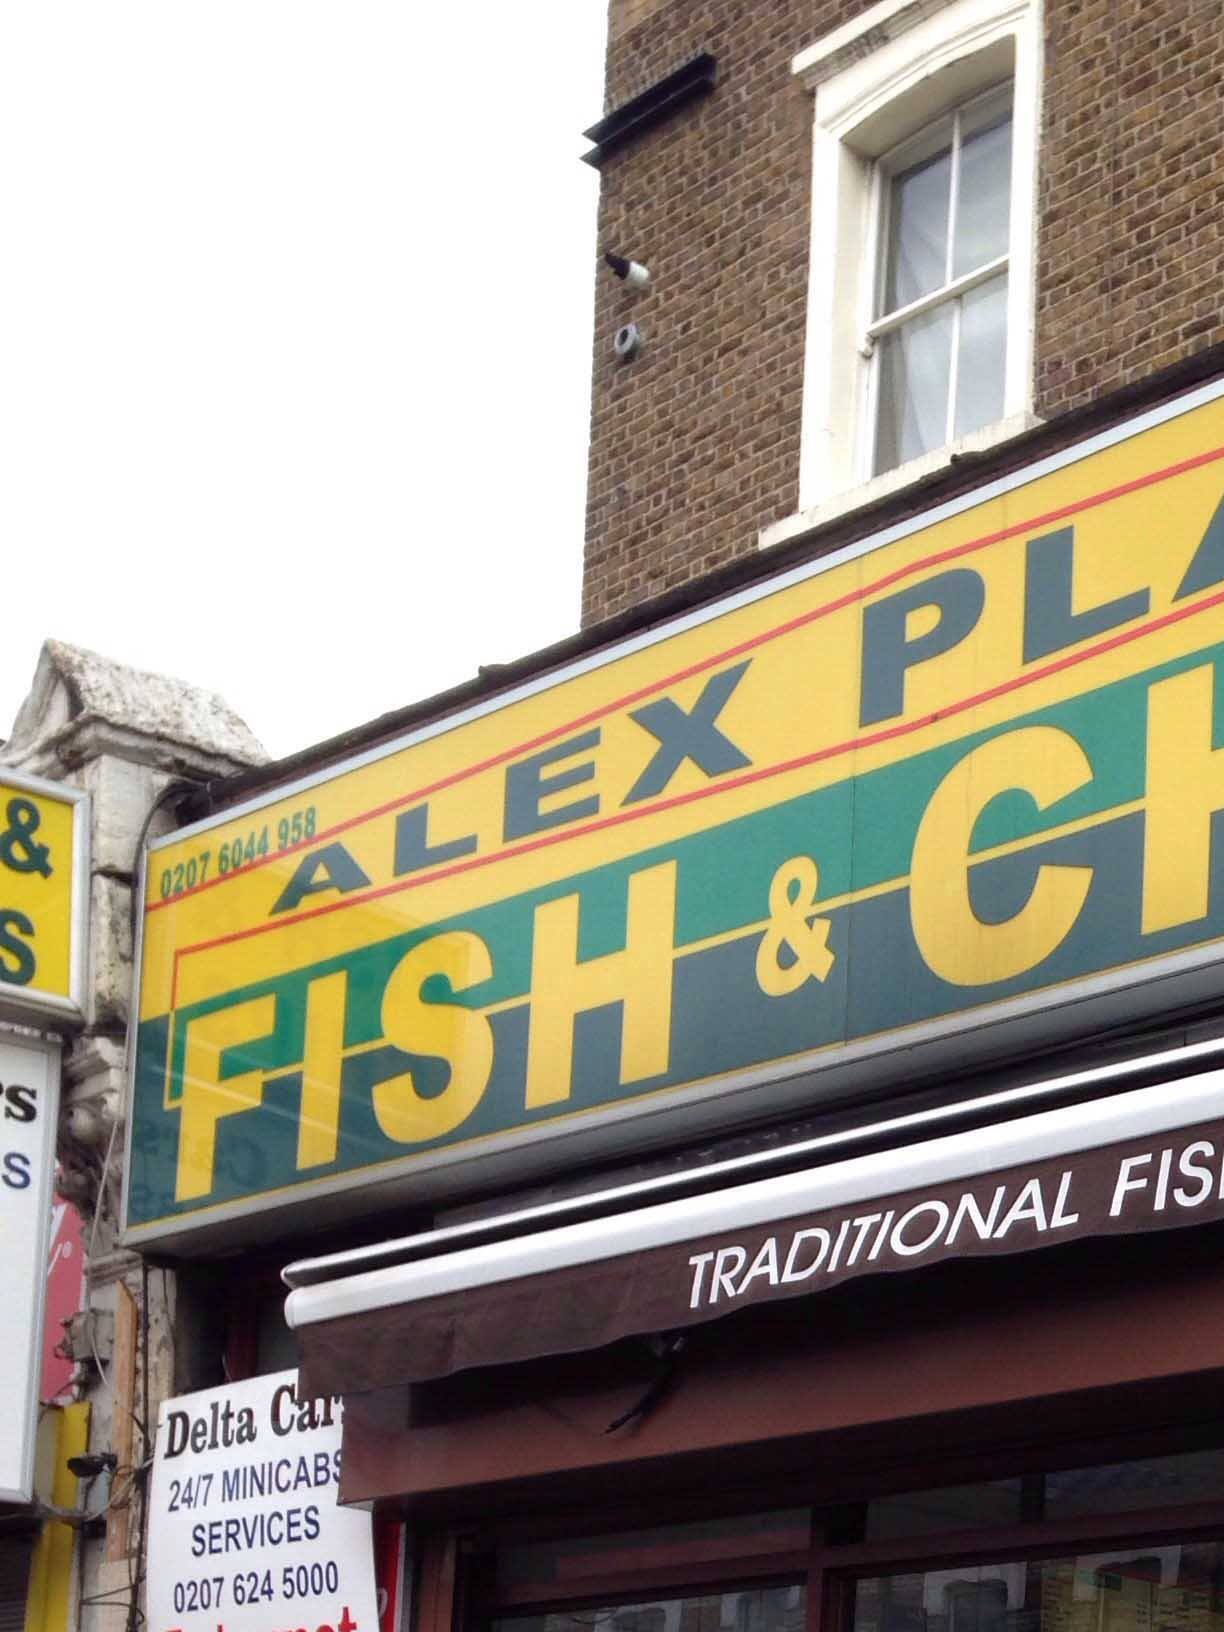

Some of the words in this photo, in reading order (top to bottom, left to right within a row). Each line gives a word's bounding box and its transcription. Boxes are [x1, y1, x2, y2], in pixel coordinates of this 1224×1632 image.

[270, 658, 752, 914] ALEX
[161, 853, 210, 898] 0207
[218, 833, 269, 880] 6044
[277, 807, 316, 852] 958
[175, 860, 678, 1202] FISH
[756, 856, 835, 997] &
[688, 1170, 1081, 1308] TRADITIONAL
[164, 1400, 257, 1459] Delta
[271, 1384, 344, 1437] Car
[168, 1474, 213, 1512] 24/7
[191, 1506, 320, 1557] SERVICES
[174, 1577, 224, 1613] 0207
[233, 1569, 274, 1604] 624
[282, 1561, 338, 1597] 5000
